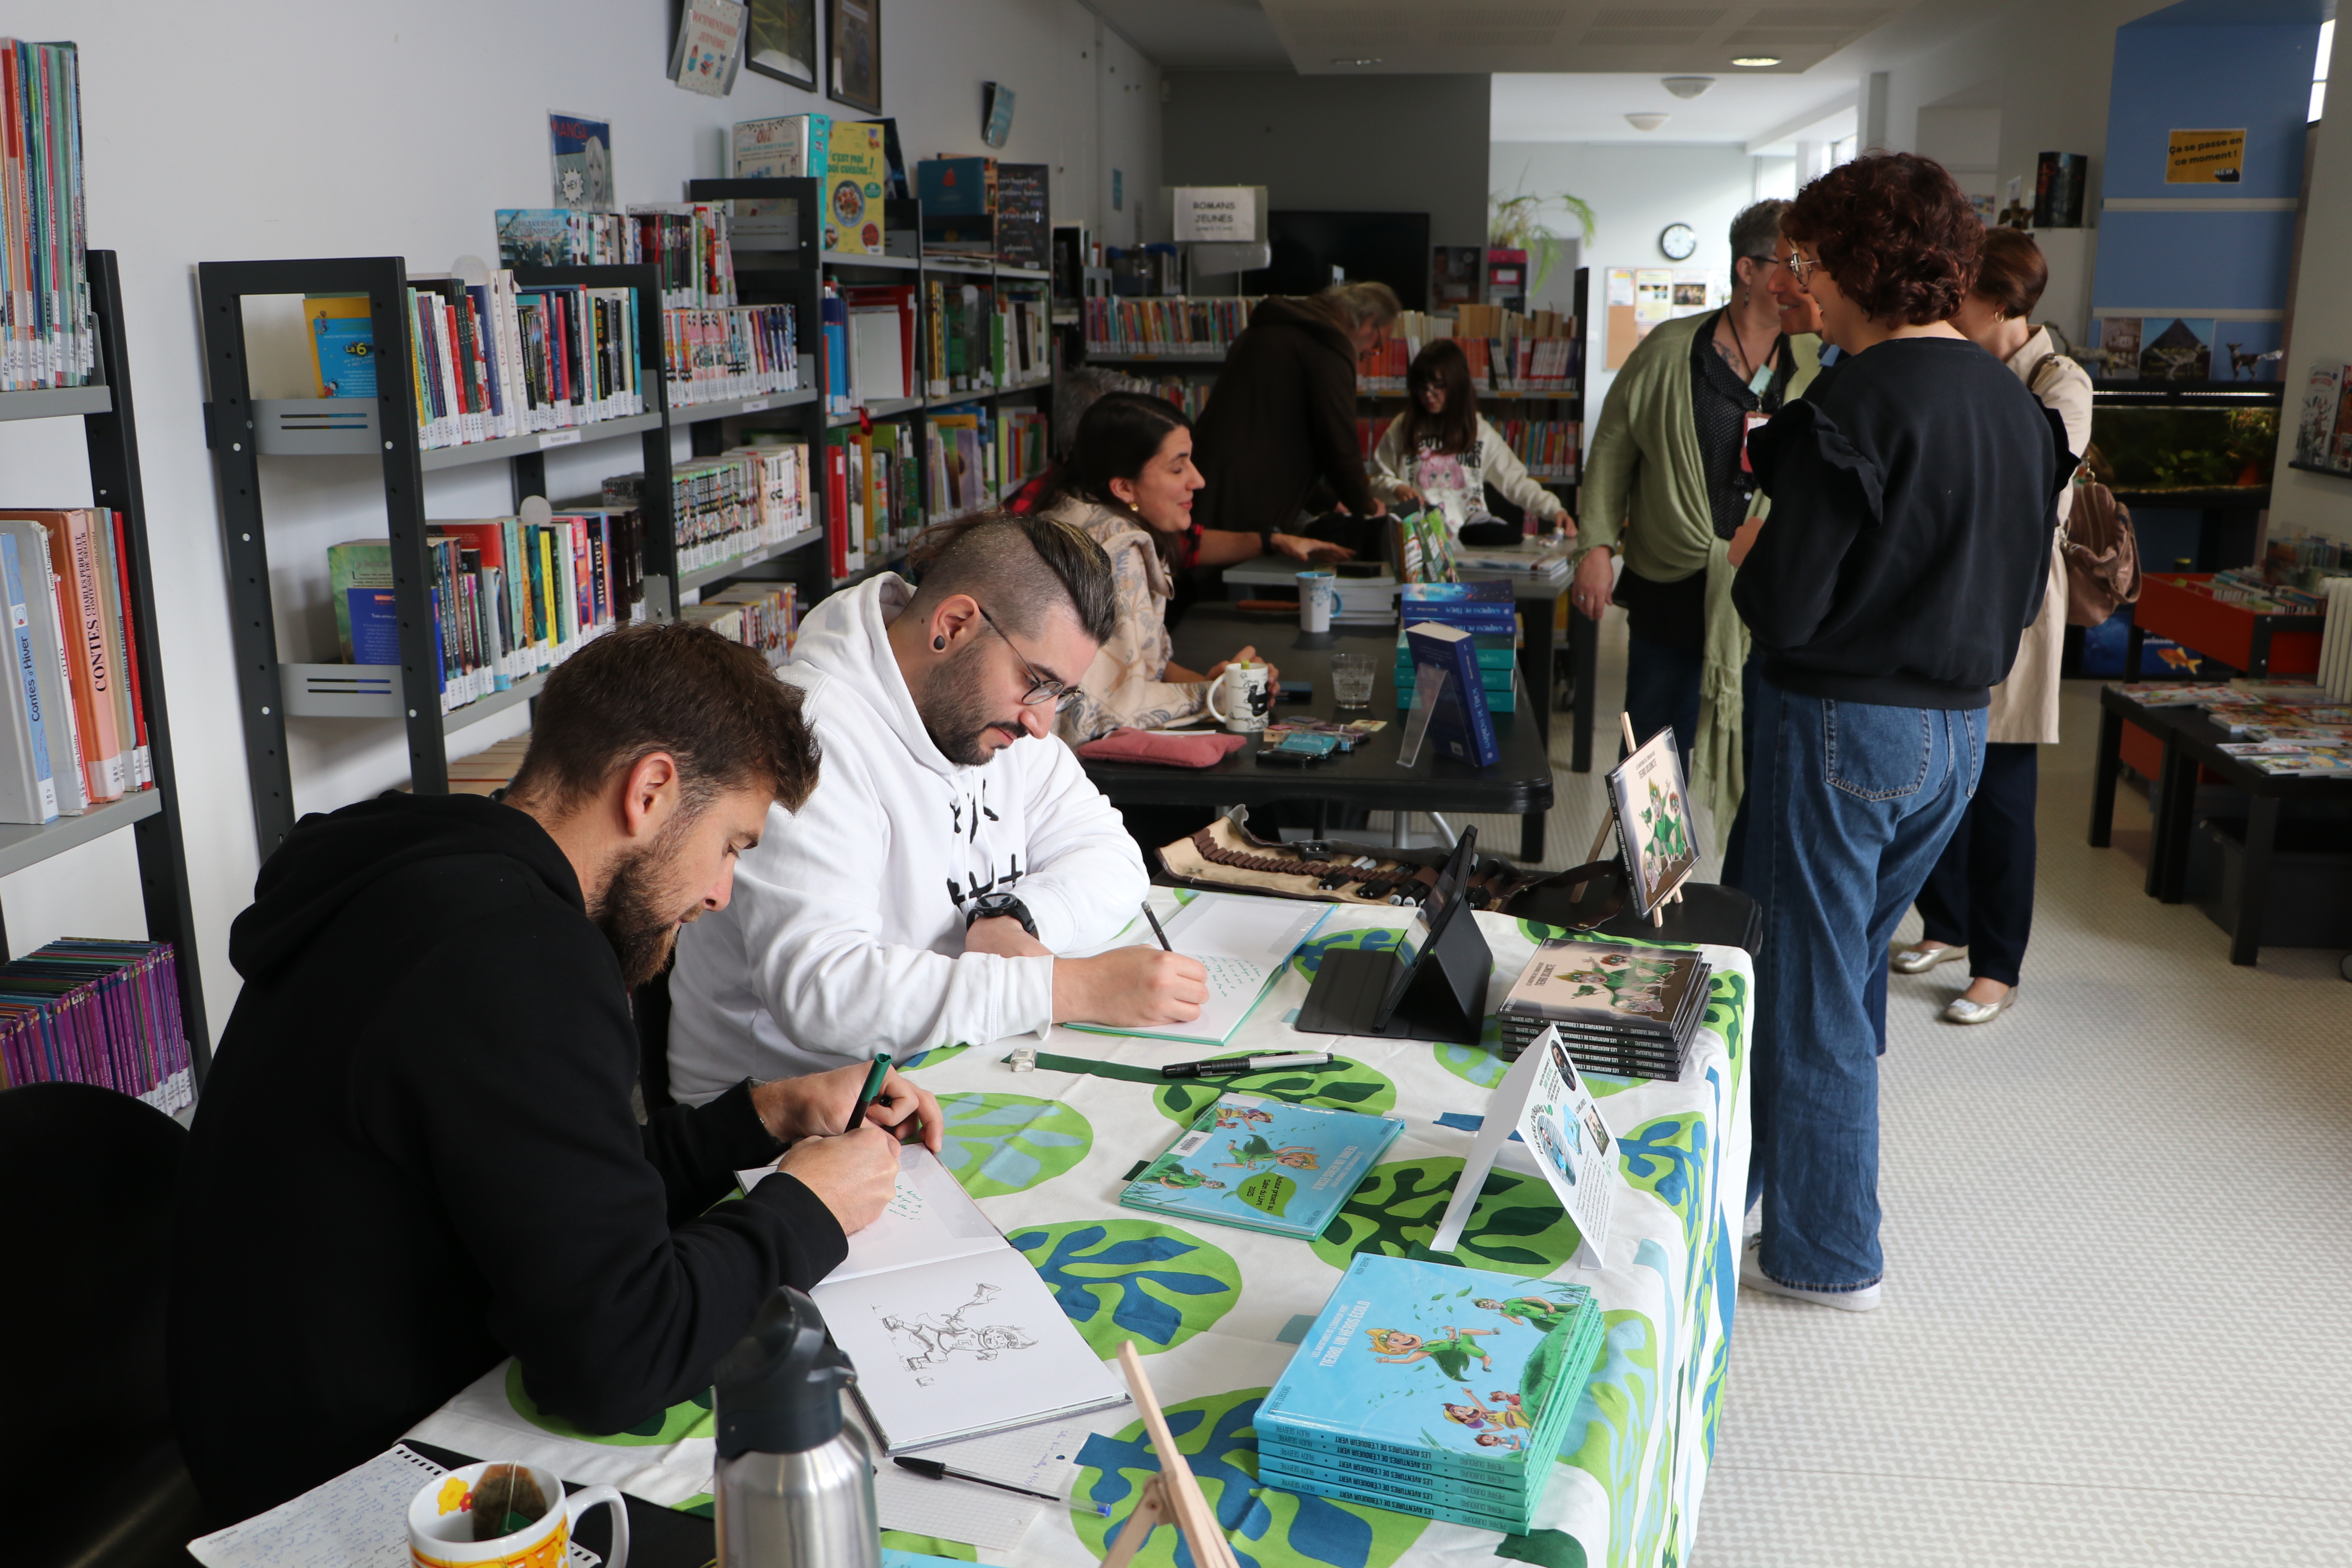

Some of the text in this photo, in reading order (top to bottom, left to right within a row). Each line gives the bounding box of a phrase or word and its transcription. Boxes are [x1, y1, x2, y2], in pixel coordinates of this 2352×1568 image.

[551, 120, 588, 140] MANGA
[2169, 145, 2182, 156] Ça
[2198, 140, 2227, 152] passe
[2189, 152, 2231, 163] moment
[1194, 214, 1234, 223] JEUNES
[32, 224, 36, 232] ET
[43, 539, 53, 569] Ungerer
[594, 535, 603, 575] TREE
[85, 561, 91, 570] DE
[75, 536, 91, 616] CHARLES PERRAULT
[86, 574, 96, 615] COMTESSE
[118, 616, 126, 649] PEARBLOSSOM
[86, 620, 107, 691] CONTES
[59, 649, 67, 676] OTTO
[26, 679, 40, 721] Contes
[1261, 1179, 1270, 1190] Salon
[1274, 1176, 1283, 1189] Auteur
[1247, 1186, 1255, 1197] 2025
[1268, 1189, 1279, 1205] présent
[1256, 1195, 1265, 1206] Livre
[1359, 1257, 1372, 1267] SEBYRE
[1314, 1333, 1332, 1351] AVENTURES
[1338, 1305, 1349, 1313] VERT
[1319, 1300, 1371, 1367] TIERRO, UN HÉROS ÉCOLO
[1267, 1385, 1291, 1414] PIERRE DUBOURG
[1276, 1425, 1294, 1435] SEBYRE
[1296, 1429, 1309, 1437] RUDY
[1278, 1434, 1297, 1444] SEBYRE
[1298, 1438, 1312, 1447] RUDY
[1335, 1436, 1348, 1444] VERT
[1350, 1438, 1378, 1450] L'ÉBOUEUR
[1280, 1448, 1299, 1458] SEBYRE
[1337, 1446, 1350, 1455] VERT
[1351, 1448, 1379, 1461] L'ÉBOUEUR
[1388, 1445, 1419, 1456] AVENTURES
[1300, 1452, 1313, 1461] RUDY
[1389, 1456, 1420, 1468] AVENTURES
[1460, 1457, 1484, 1467] DUBOURG
[1280, 1462, 1299, 1472] SEBYRE
[1338, 1460, 1351, 1469] VERT
[1353, 1463, 1381, 1476] L'ÉBOUEUR
[1421, 1462, 1431, 1470] LES
[1485, 1461, 1504, 1470] PIERRE
[1300, 1466, 1313, 1475] RUDY
[1460, 1469, 1484, 1480] DUBOURG
[1338, 1474, 1351, 1483] VERT
[1390, 1470, 1421, 1483] AVENTURES
[1423, 1477, 1432, 1485] LES
[1485, 1474, 1504, 1483] PIERRE
[1281, 1478, 1299, 1488] SEBYRE
[1301, 1482, 1314, 1491] RUDY
[1353, 1477, 1381, 1490] L'ÉBOUEUR
[1339, 1490, 1352, 1499] VERT
[1390, 1485, 1421, 1497] AVENTURES
[1423, 1491, 1432, 1499] LES
[1461, 1485, 1485, 1496] DUBOURG
[1486, 1490, 1505, 1500] PIERRE
[1354, 1493, 1382, 1506] L'ÉBOUEUR
[1461, 1499, 1485, 1510] DUBOURG
[1391, 1501, 1422, 1514] AVENTURES
[1424, 1507, 1433, 1515] LES
[1486, 1504, 1505, 1514] PIERRE
[1462, 1515, 1486, 1526] DUBOURG
[1486, 1520, 1506, 1530] PIERRE
